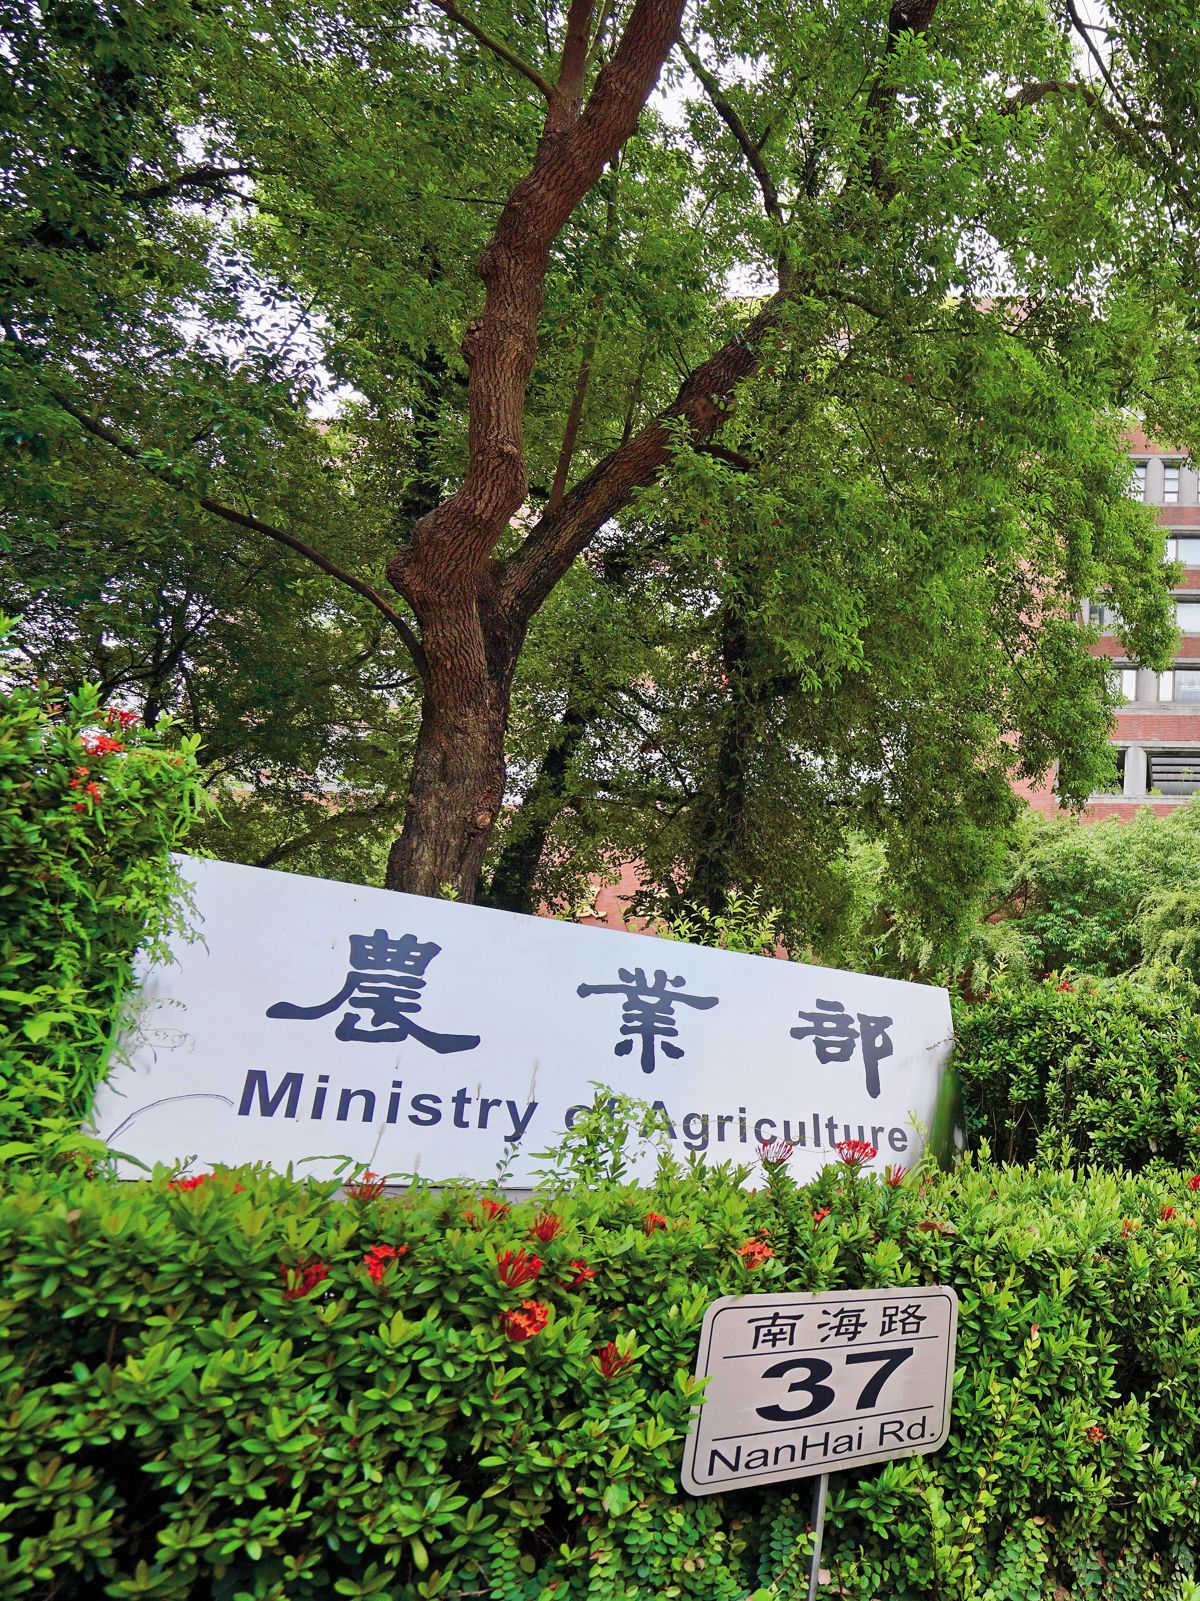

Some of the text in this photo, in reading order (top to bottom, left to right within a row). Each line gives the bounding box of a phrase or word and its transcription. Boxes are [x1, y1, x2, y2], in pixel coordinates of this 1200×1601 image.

[266, 928, 894, 1099] 農業部
[237, 1069, 539, 1143] Ministry
[639, 1099, 908, 1153] Agriculture
[747, 1303, 928, 1350] 南海路
[755, 1347, 914, 1422] 37
[706, 1415, 936, 1477] NanHai Rd.
